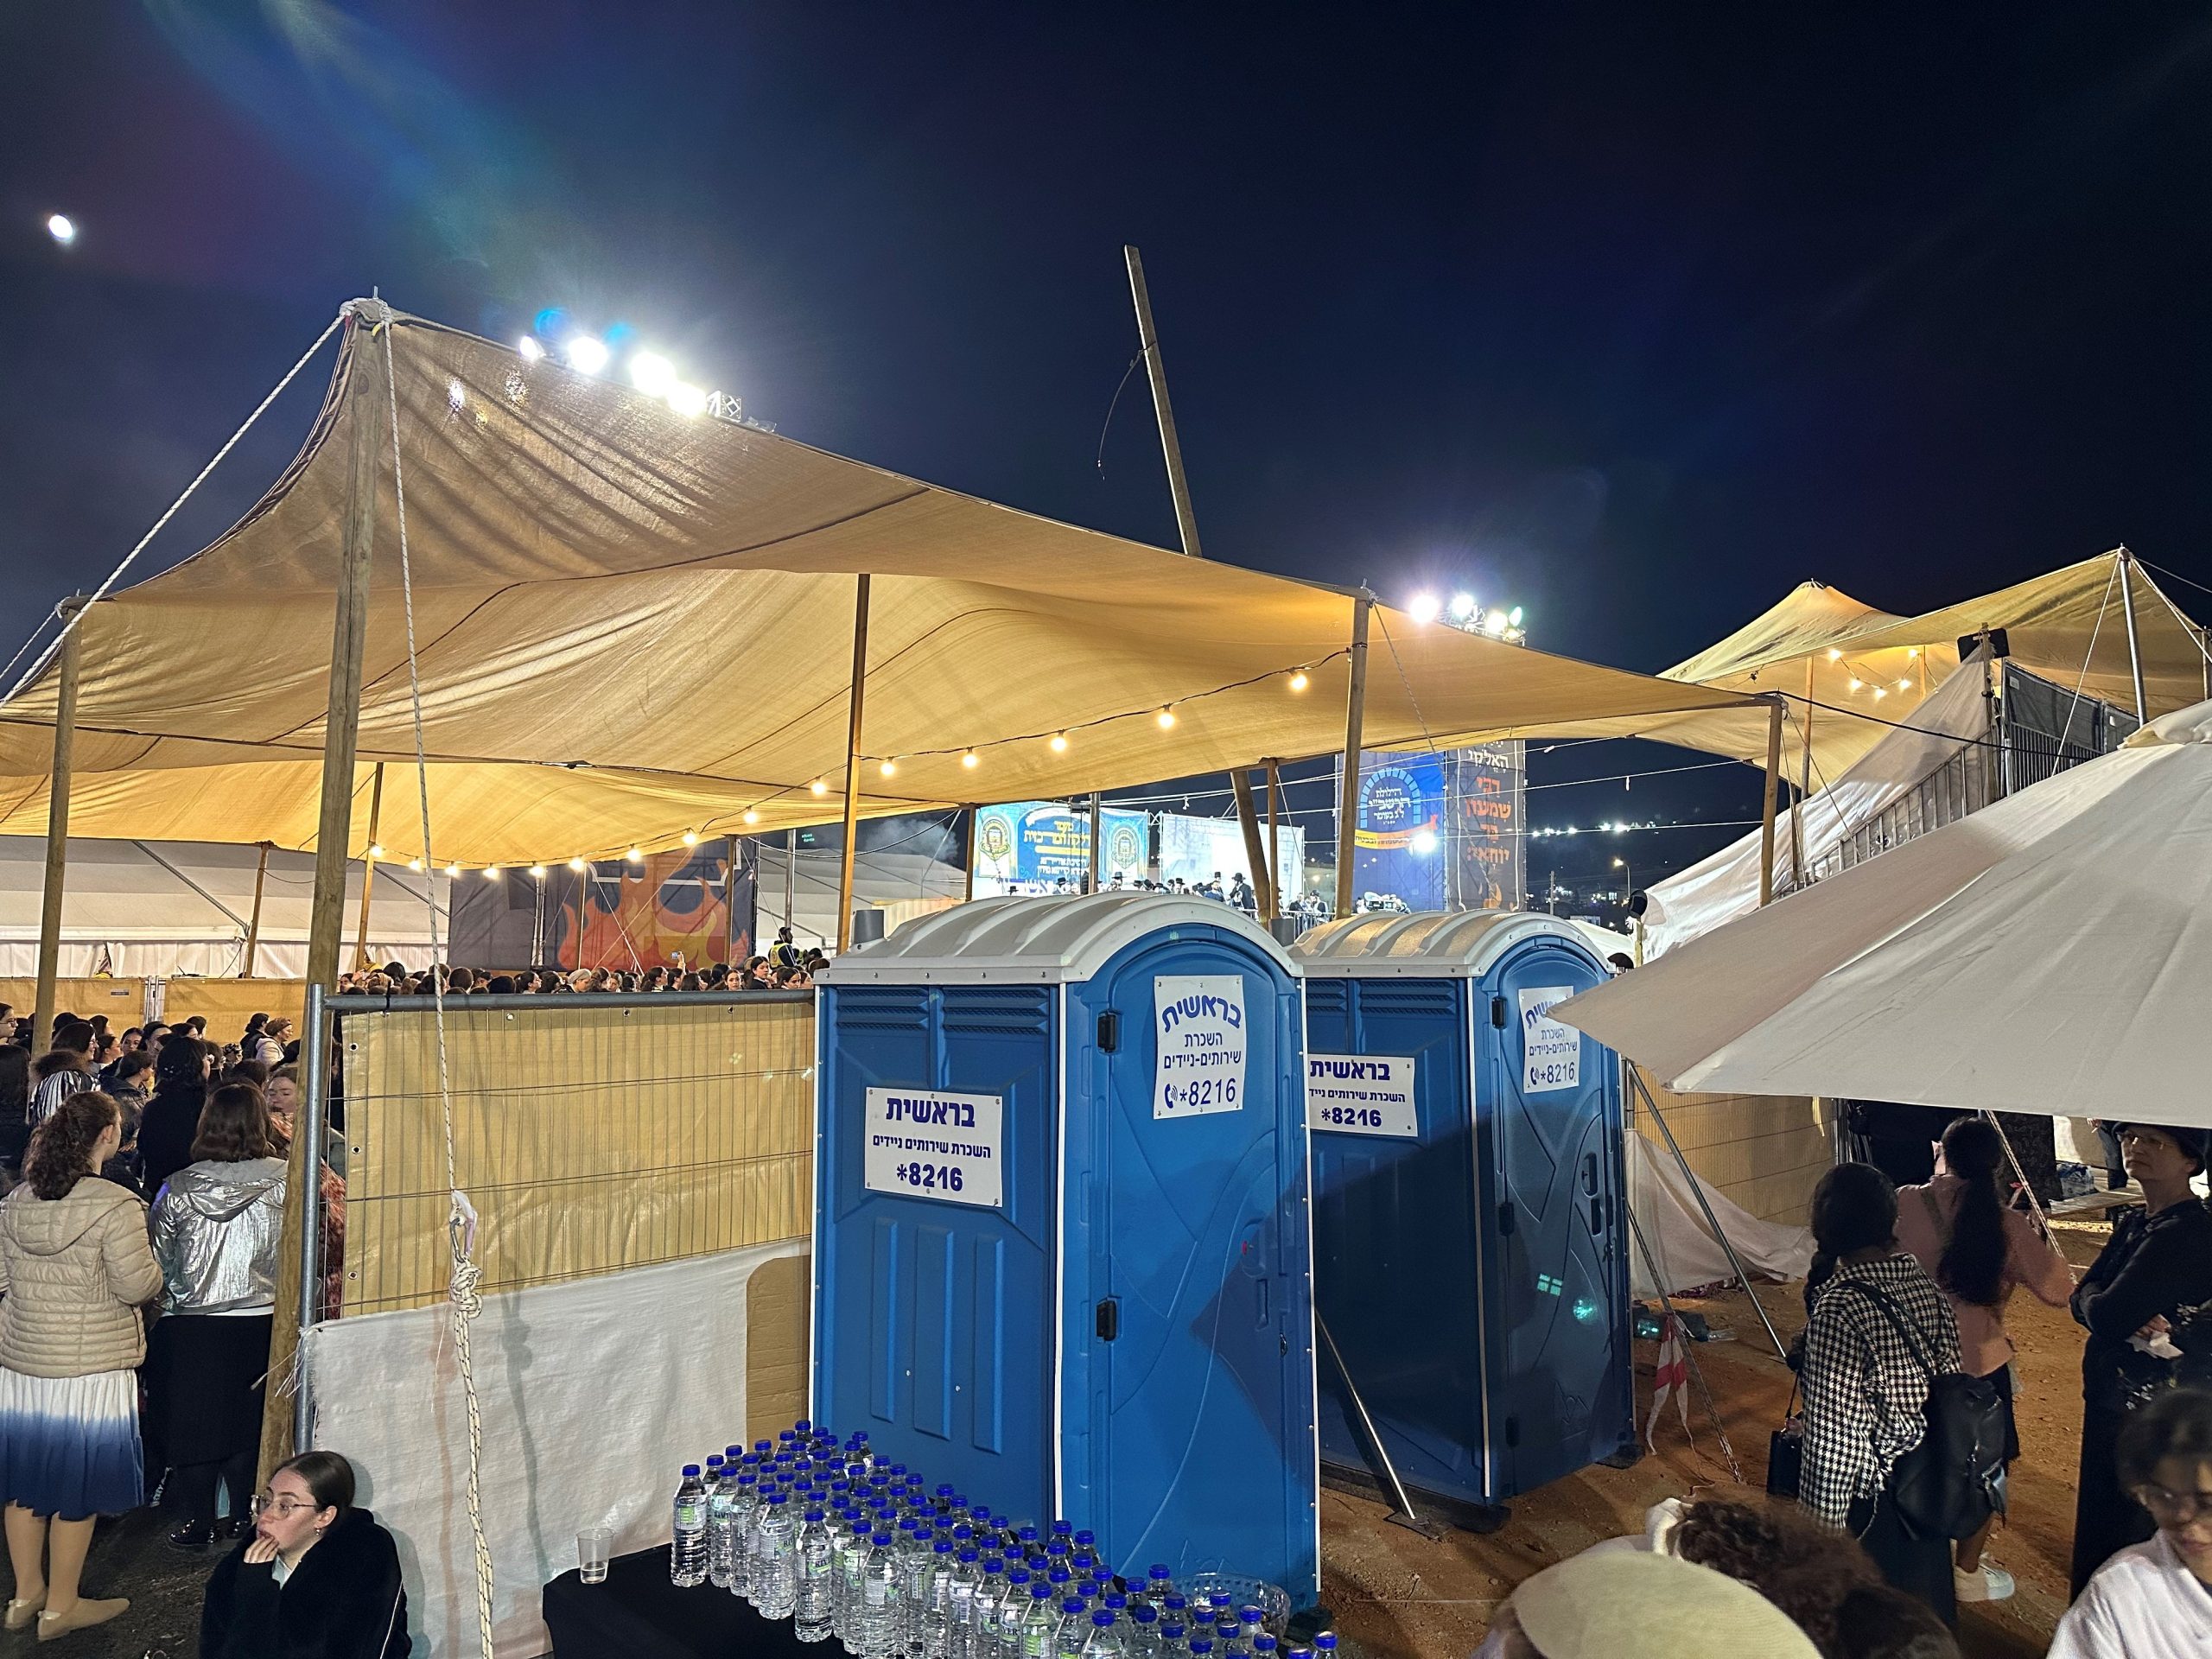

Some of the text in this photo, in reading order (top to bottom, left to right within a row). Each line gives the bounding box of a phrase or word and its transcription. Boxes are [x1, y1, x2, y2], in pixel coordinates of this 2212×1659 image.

[1162, 995, 1242, 1033] בראשית
[1185, 1032, 1223, 1047] השכרת
[1541, 1028, 1565, 1040] השכרת
[1529, 1041, 1578, 1056] שירותים-ניידים
[1164, 1051, 1242, 1069] שירותים-ניידים
[1310, 1059, 1390, 1081] בראשית
[1309, 1089, 1406, 1103] השכרת שירותים נייד
[886, 1097, 975, 1128] בראשית
[873, 1135, 991, 1158] השכרת שירותים ניידים
